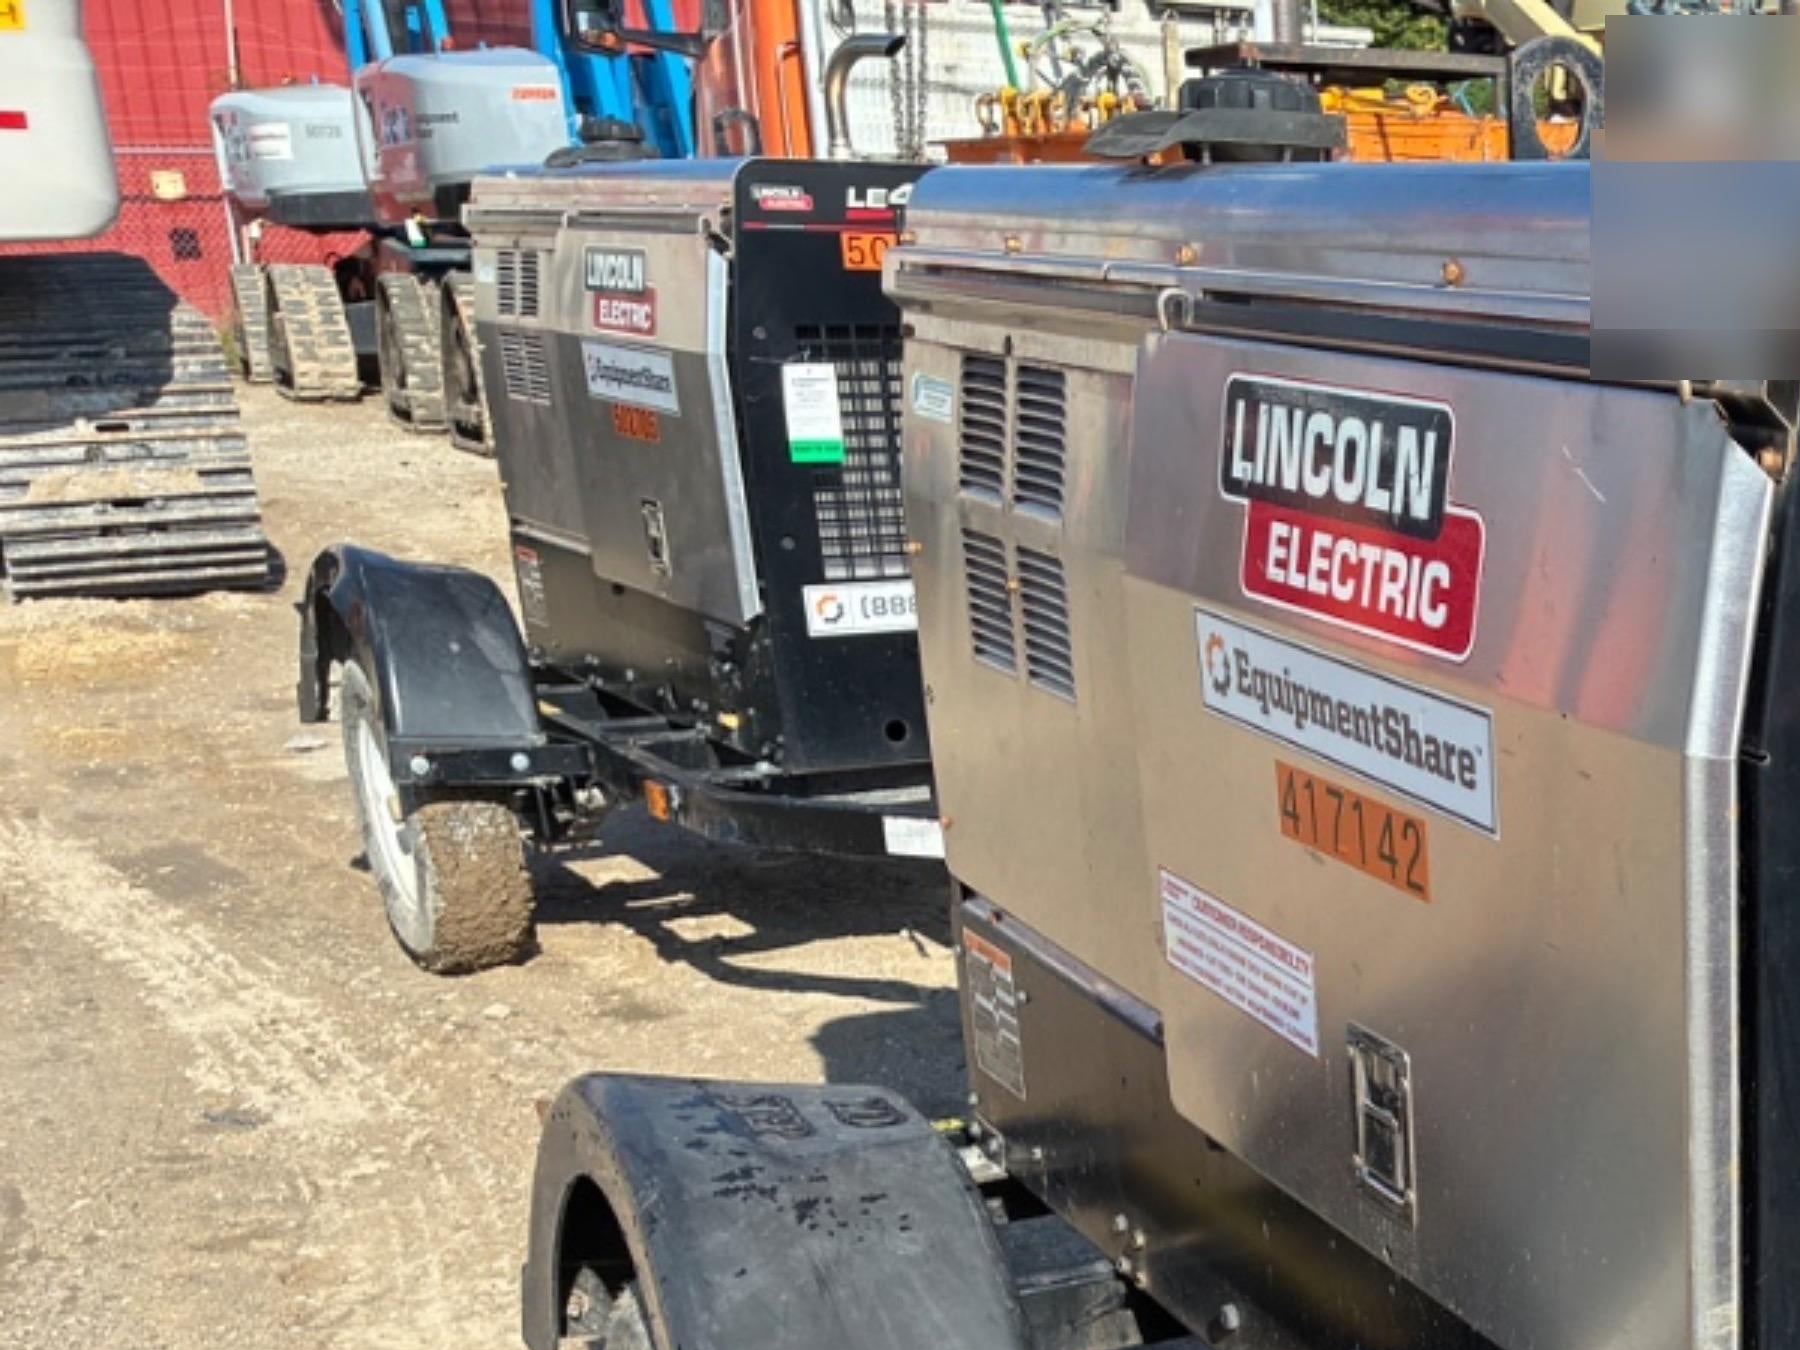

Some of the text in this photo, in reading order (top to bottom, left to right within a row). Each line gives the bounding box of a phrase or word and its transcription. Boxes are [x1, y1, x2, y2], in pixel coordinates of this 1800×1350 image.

[587, 252, 643, 291] LINCOLN
[600, 299, 651, 331] ELECTRIC
[1232, 399, 1436, 520] LINCOLN
[1266, 521, 1450, 628] ELECTRIC
[1233, 648, 1477, 789] EquipmentShare
[1281, 771, 1424, 893] 417142
